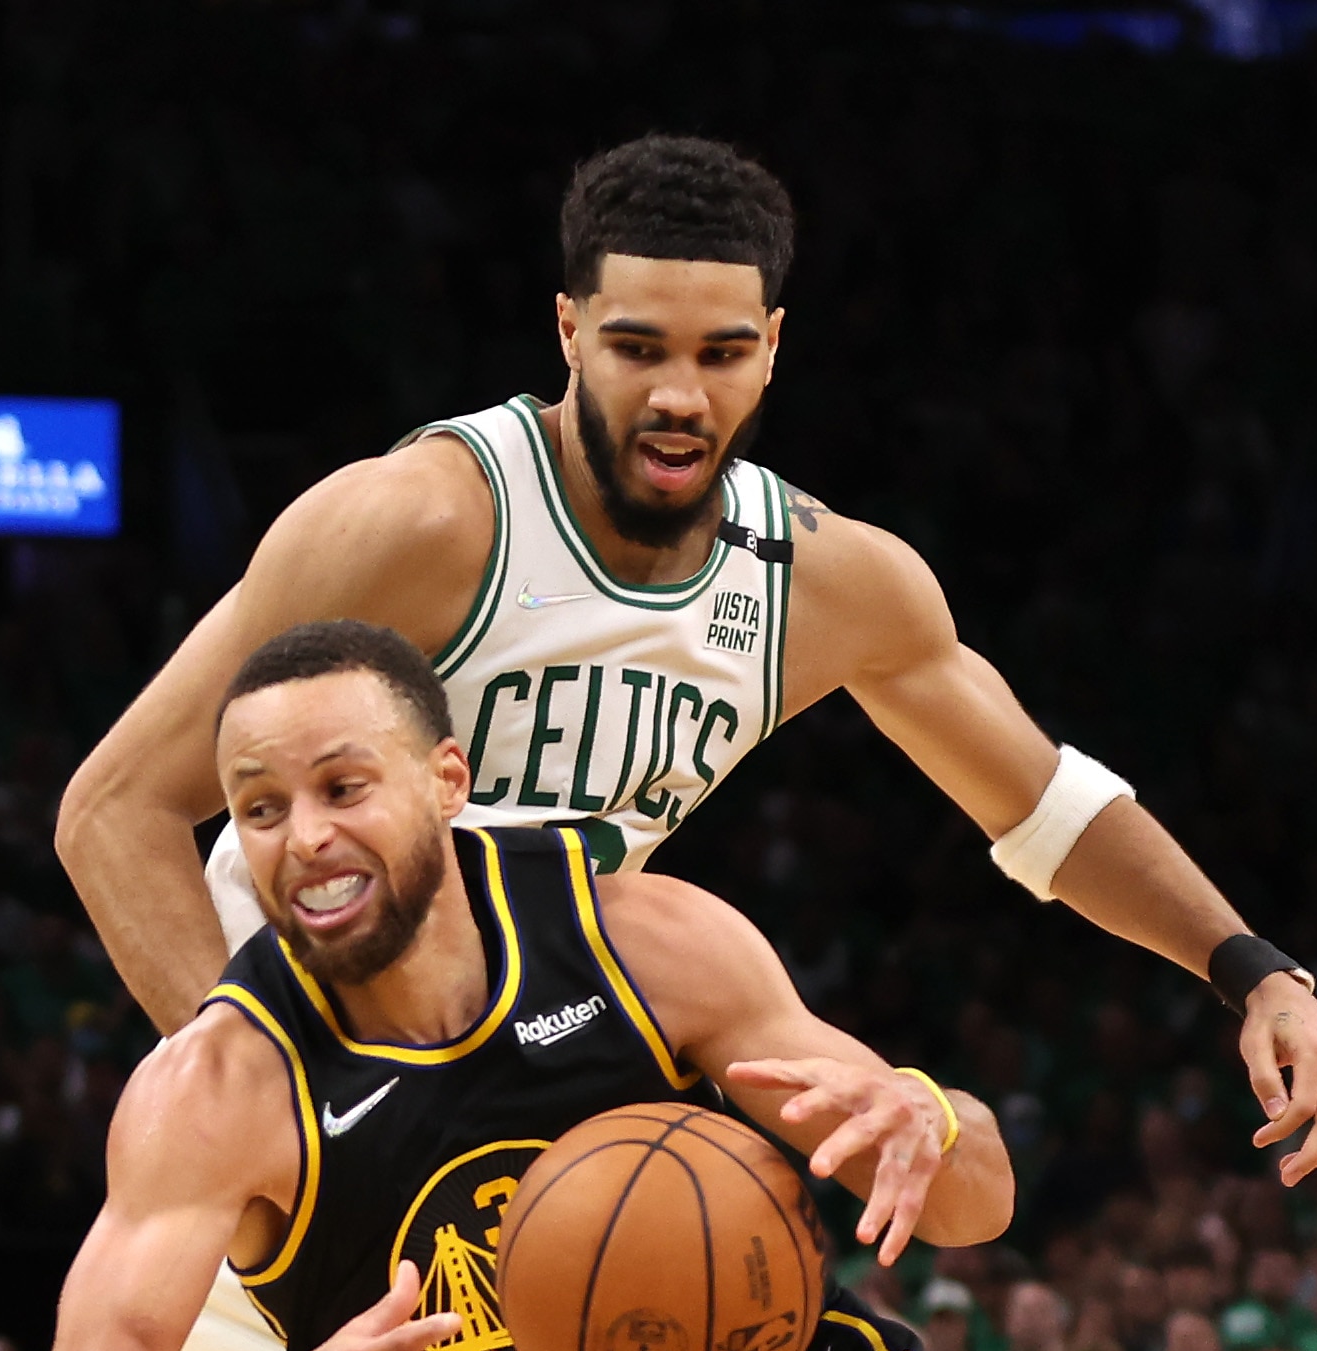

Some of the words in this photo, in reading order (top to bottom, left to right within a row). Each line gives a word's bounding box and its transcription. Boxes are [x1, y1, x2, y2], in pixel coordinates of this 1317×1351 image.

[712, 591, 760, 630] VISTA
[706, 623, 757, 653] PRINT
[468, 665, 738, 831] CELTICS
[514, 995, 607, 1045] Rakuten
